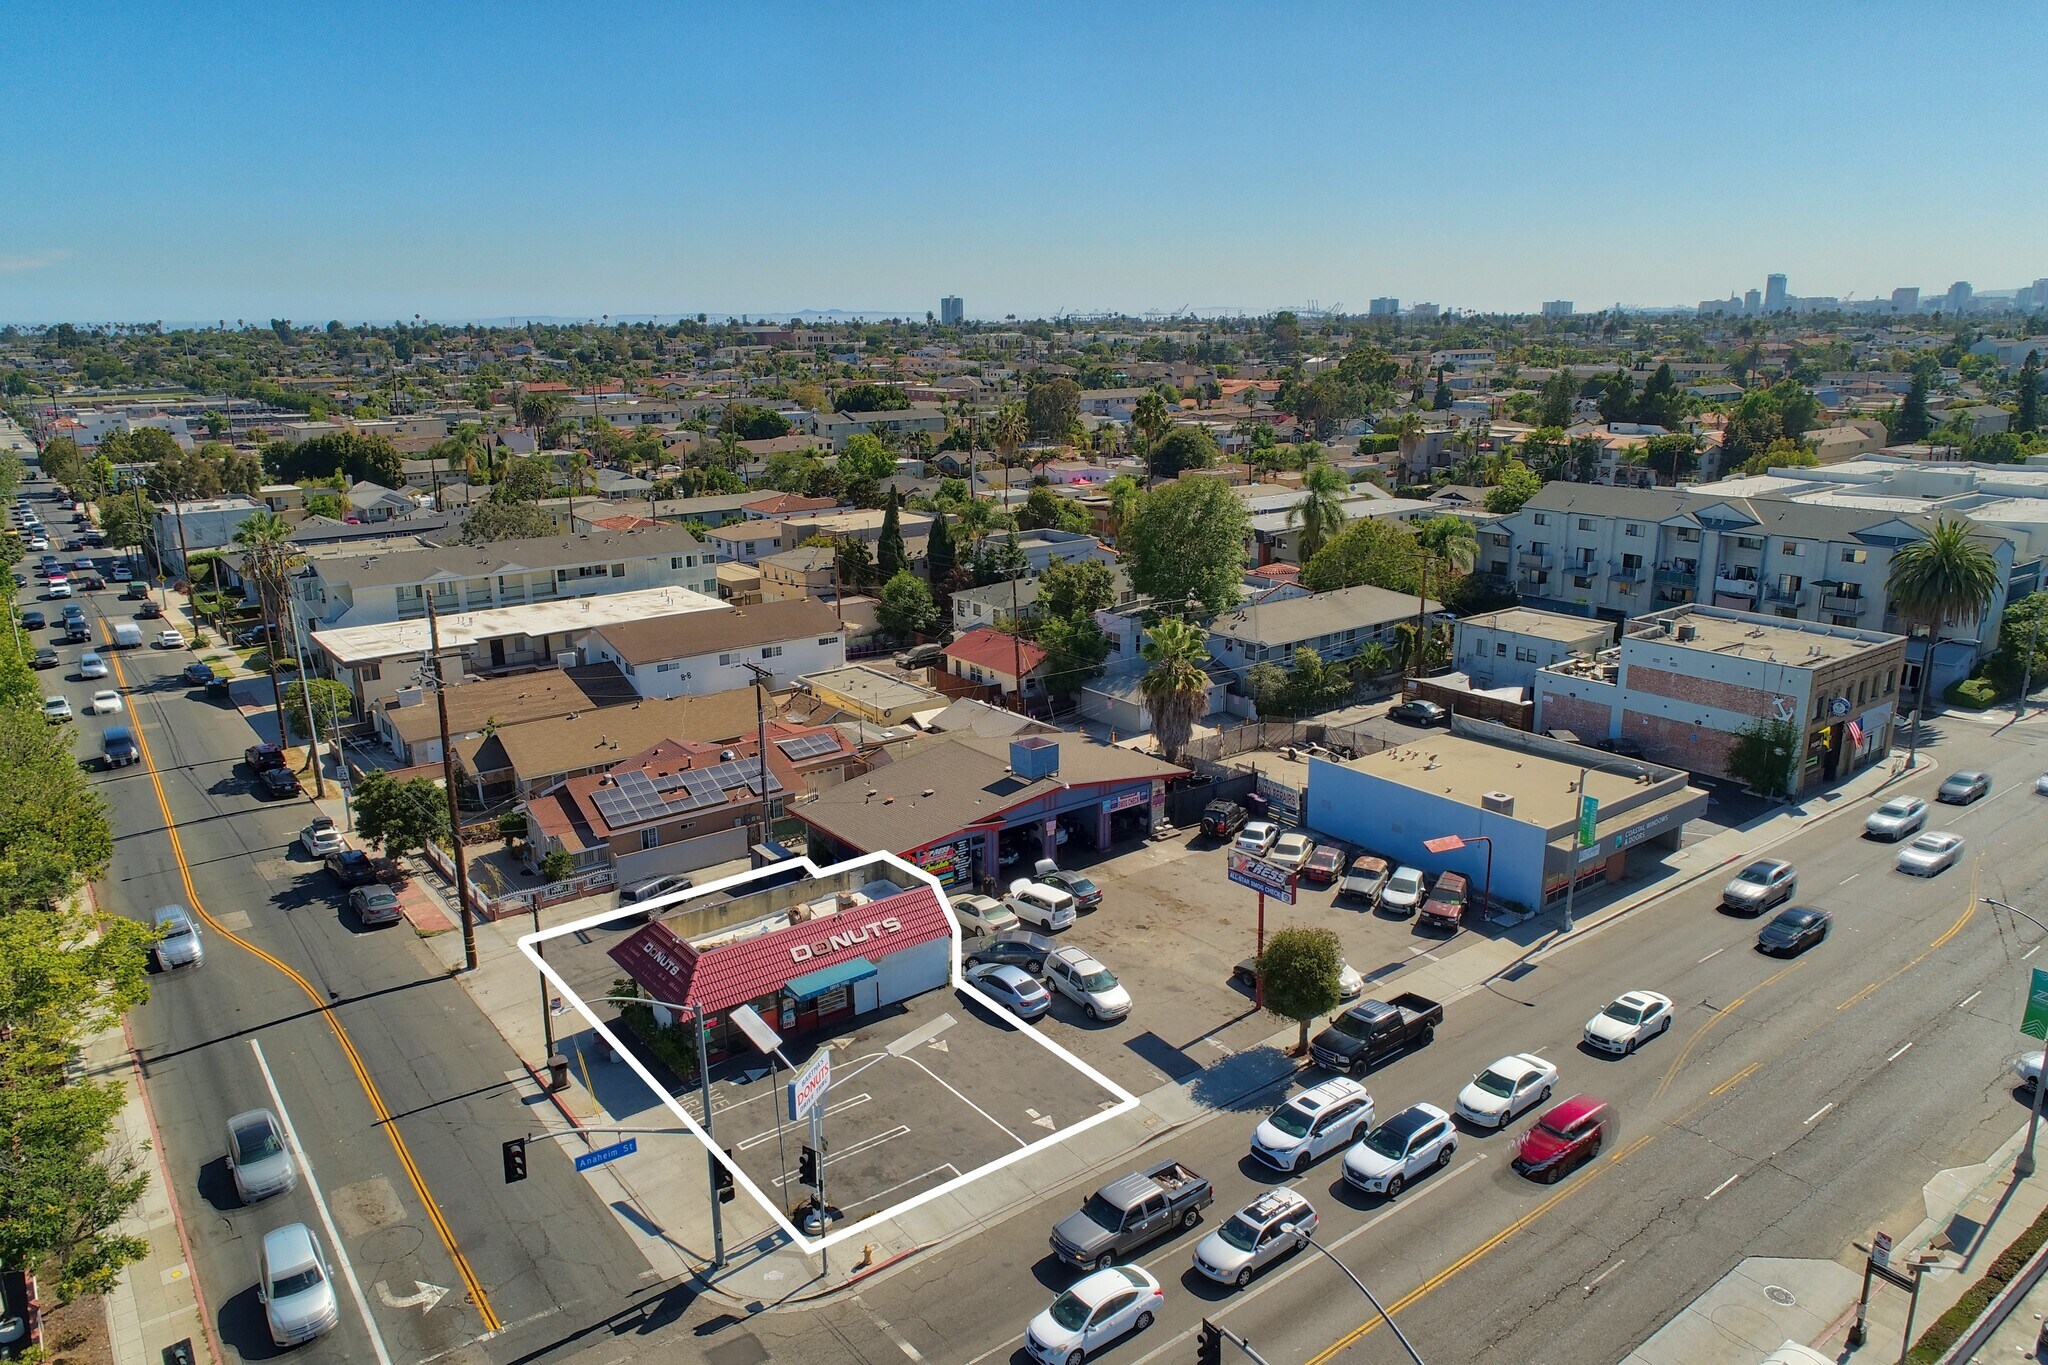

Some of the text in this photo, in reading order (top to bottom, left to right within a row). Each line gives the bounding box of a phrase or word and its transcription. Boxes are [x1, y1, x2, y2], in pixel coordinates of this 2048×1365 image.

[1625, 814, 1669, 839] COASTAL WINDOWS
[1629, 831, 1646, 845] DOORS
[1233, 851, 1287, 883] XPRESS
[1250, 880, 1265, 892] SMOG
[1265, 886, 1281, 898] CHECK
[790, 916, 902, 964] DONUTS
[643, 941, 680, 976] DONUTS
[797, 1062, 829, 1106] DONUTS
[800, 1079, 828, 1113] DRIVE THRU
[580, 1142, 634, 1168] Anaheim St
